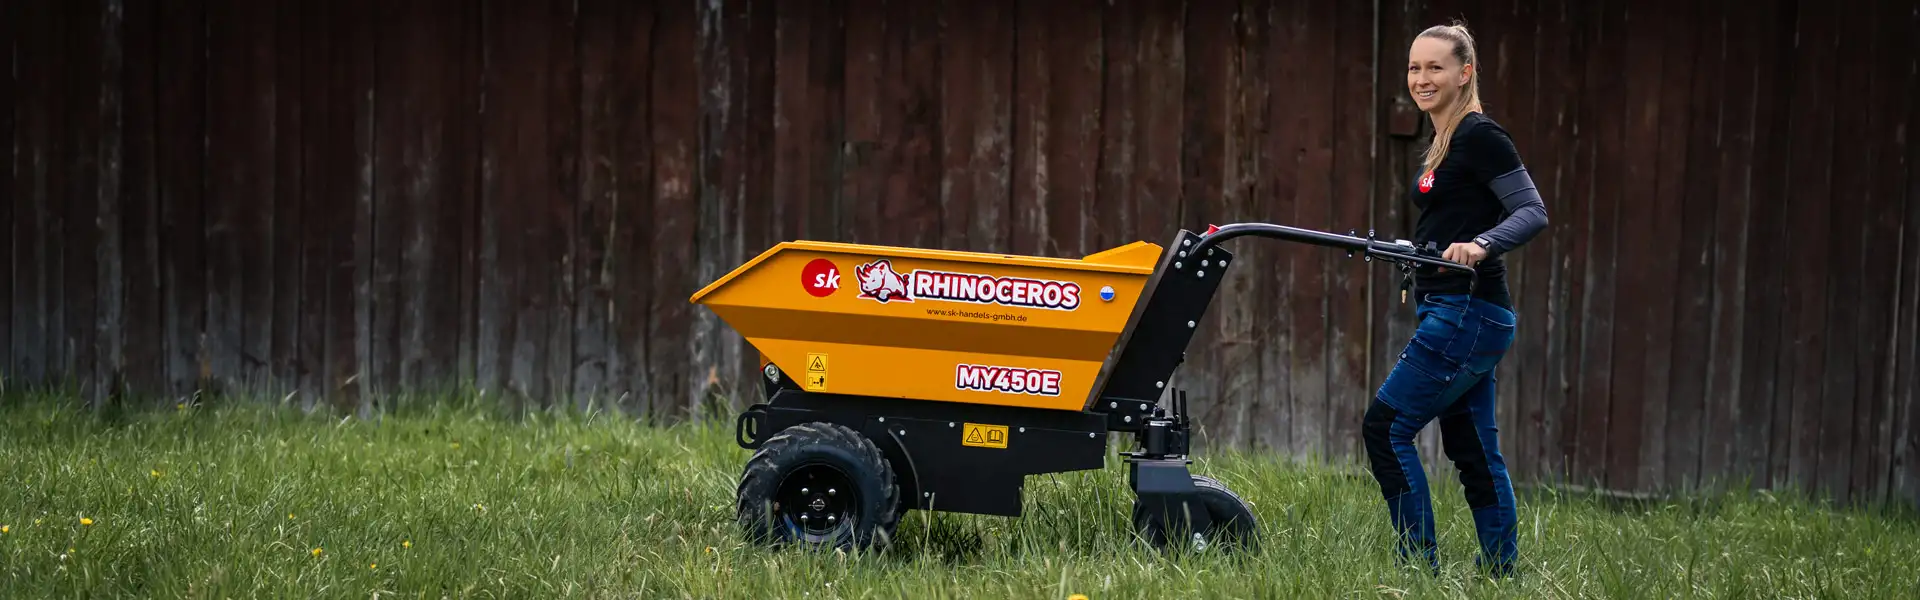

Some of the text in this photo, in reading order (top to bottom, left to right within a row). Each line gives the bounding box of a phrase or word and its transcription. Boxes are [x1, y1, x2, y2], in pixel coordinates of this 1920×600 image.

[813, 268, 841, 289] sk
[915, 271, 1080, 309] RHINOCEROS
[926, 308, 1028, 323] www.sk-handels-gmbh.de
[958, 366, 1060, 394] MY450E
